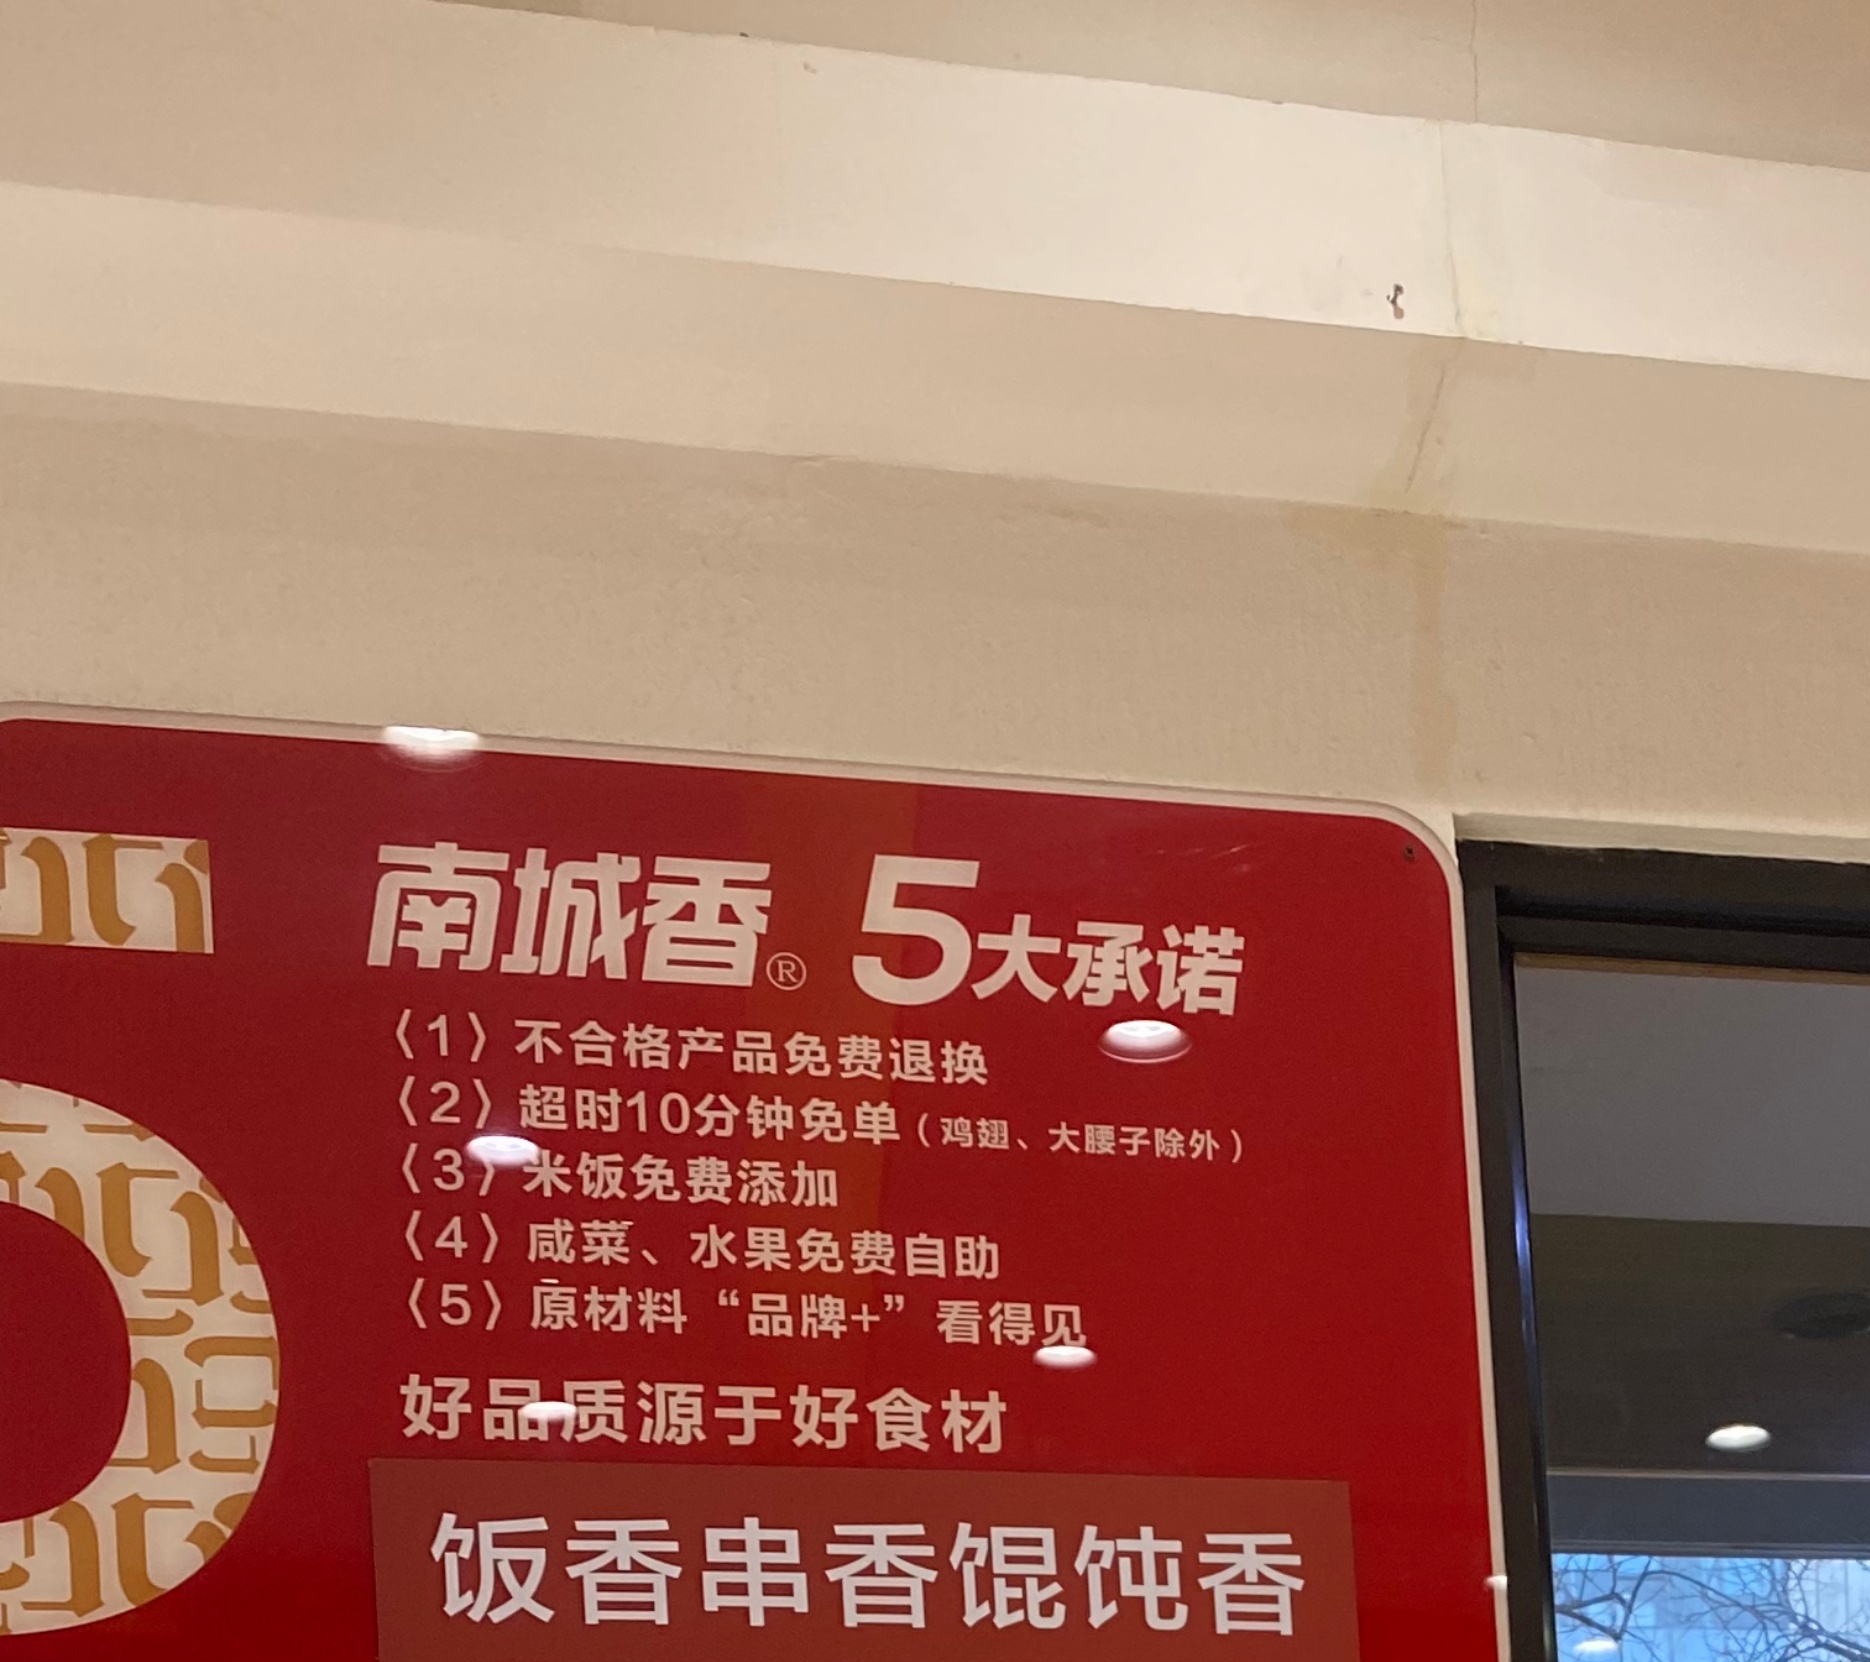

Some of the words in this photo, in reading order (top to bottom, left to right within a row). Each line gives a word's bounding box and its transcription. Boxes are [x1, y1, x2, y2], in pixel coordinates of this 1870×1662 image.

[366, 842, 772, 988] 南城香
[852, 854, 1246, 1016] 5大承诺
[514, 1019, 989, 1085] 不合格产品免费退换
[523, 1149, 839, 1208] 米饭免费添加
[400, 1372, 1008, 1455] 好品质源于好食材
[430, 1512, 1305, 1636] 饭香串香馄饨香
